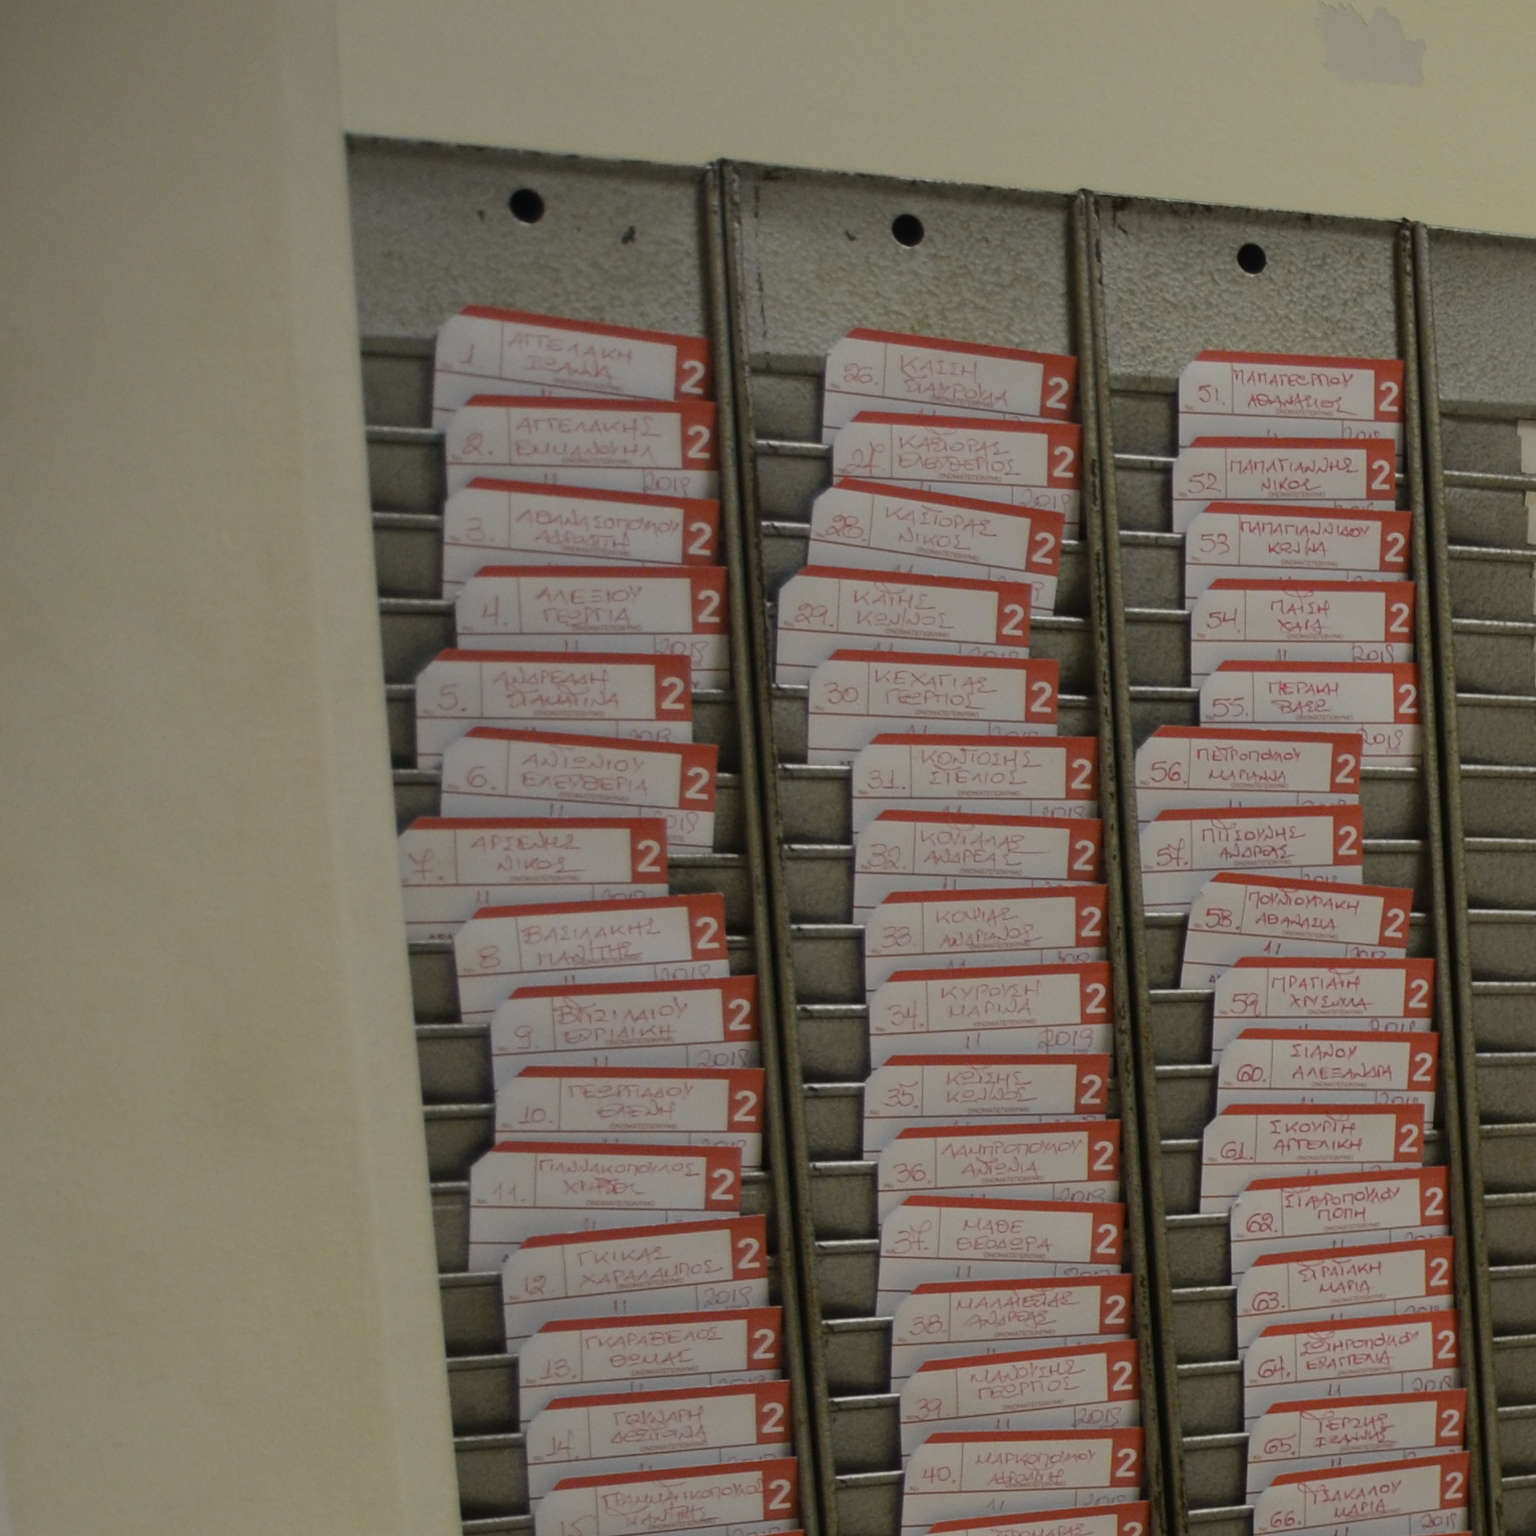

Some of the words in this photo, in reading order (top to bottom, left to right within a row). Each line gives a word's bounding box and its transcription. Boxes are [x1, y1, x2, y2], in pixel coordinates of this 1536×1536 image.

[1380, 382, 1400, 412] 2
[1053, 446, 1077, 479] 2
[662, 676, 686, 710] 2
[1031, 681, 1052, 713] 2
[1336, 754, 1356, 783] 2
[1073, 840, 1096, 871] 2
[697, 917, 720, 949] 2
[1413, 1053, 1432, 1081] 2
[734, 1090, 758, 1122] 2
[1093, 1141, 1114, 1170] 2
[1426, 1187, 1443, 1216] 2
[752, 1329, 777, 1360] 2
[1113, 1361, 1134, 1391] 2
[769, 1479, 792, 1510] 2
[1445, 1472, 1463, 1499] 2
